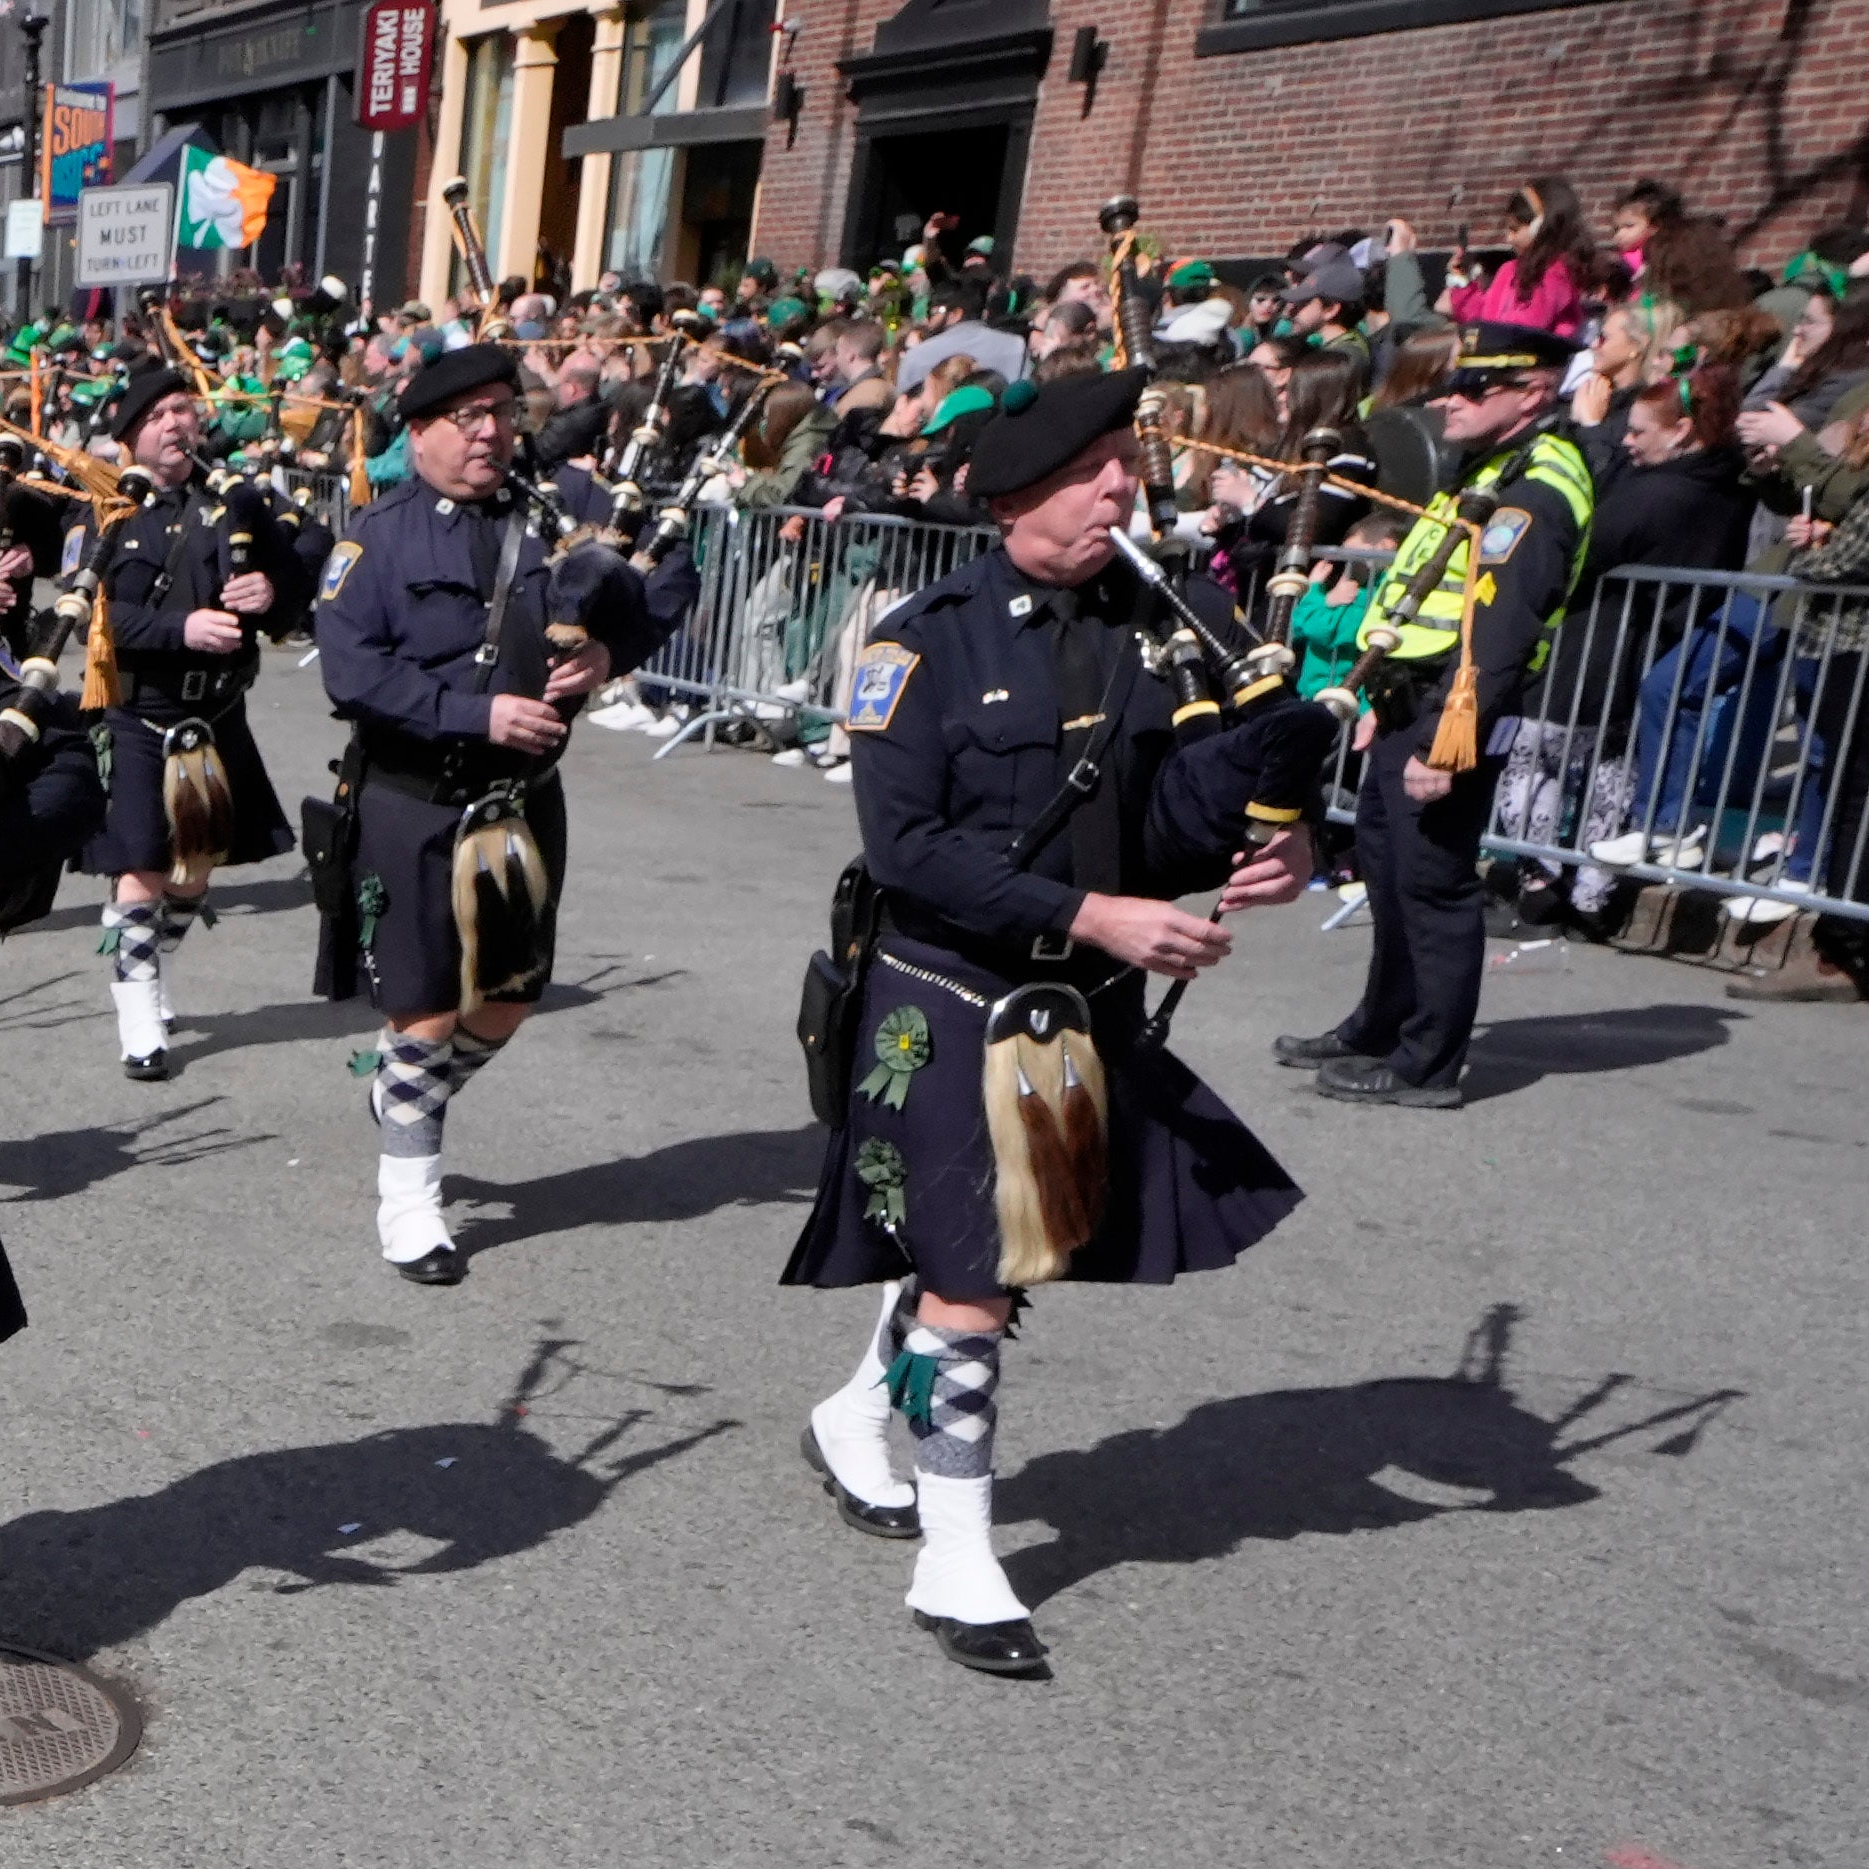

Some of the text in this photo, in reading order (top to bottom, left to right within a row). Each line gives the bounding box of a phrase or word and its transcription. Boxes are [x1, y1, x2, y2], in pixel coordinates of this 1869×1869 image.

[398, 7, 425, 76] HOUSE
[369, 10, 400, 117] TERIYAKI
[90, 199, 160, 217] LEFT LANE
[100, 225, 148, 246] MUST
[87, 253, 159, 273] TURN LEFT
